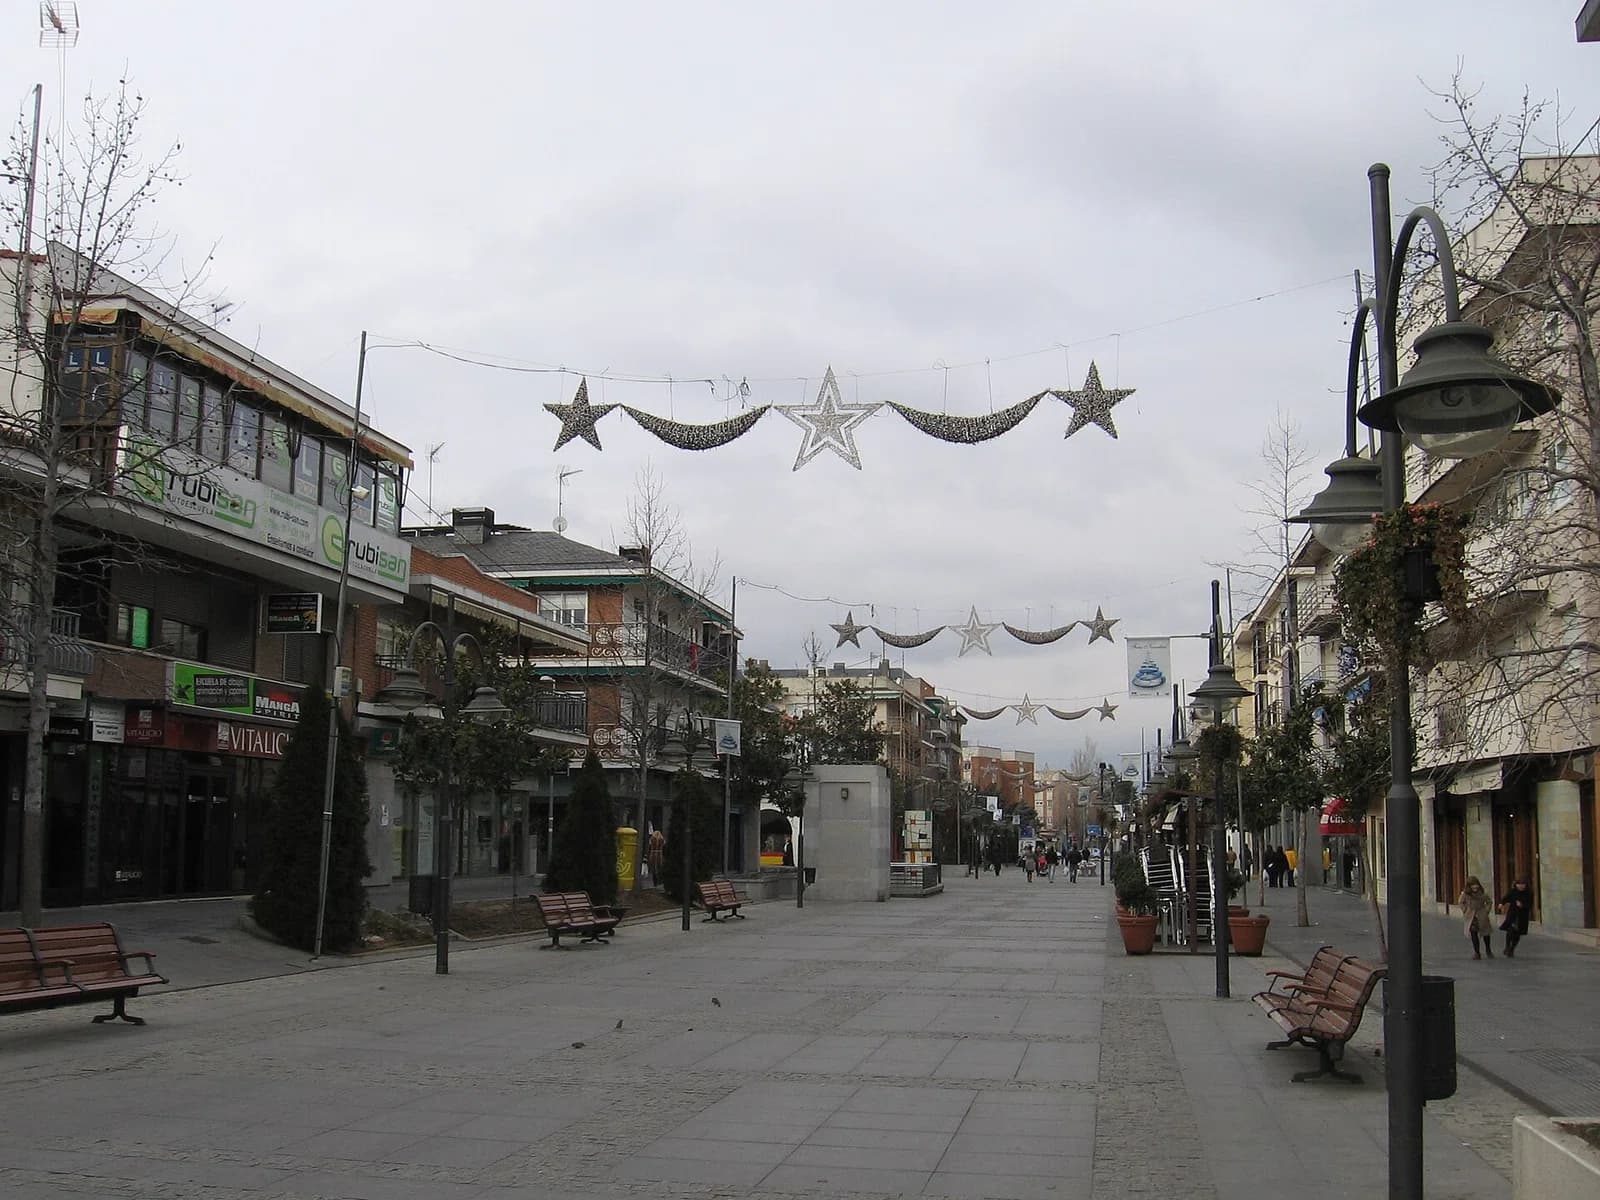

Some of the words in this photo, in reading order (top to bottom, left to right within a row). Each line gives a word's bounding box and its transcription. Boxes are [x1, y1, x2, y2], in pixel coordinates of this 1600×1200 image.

[96, 351, 105, 365] L
[302, 443, 312, 475] L
[168, 469, 256, 519] rubisan
[348, 539, 407, 573] rubisan
[255, 694, 301, 713] MANGA
[255, 706, 301, 719] SPIRIT
